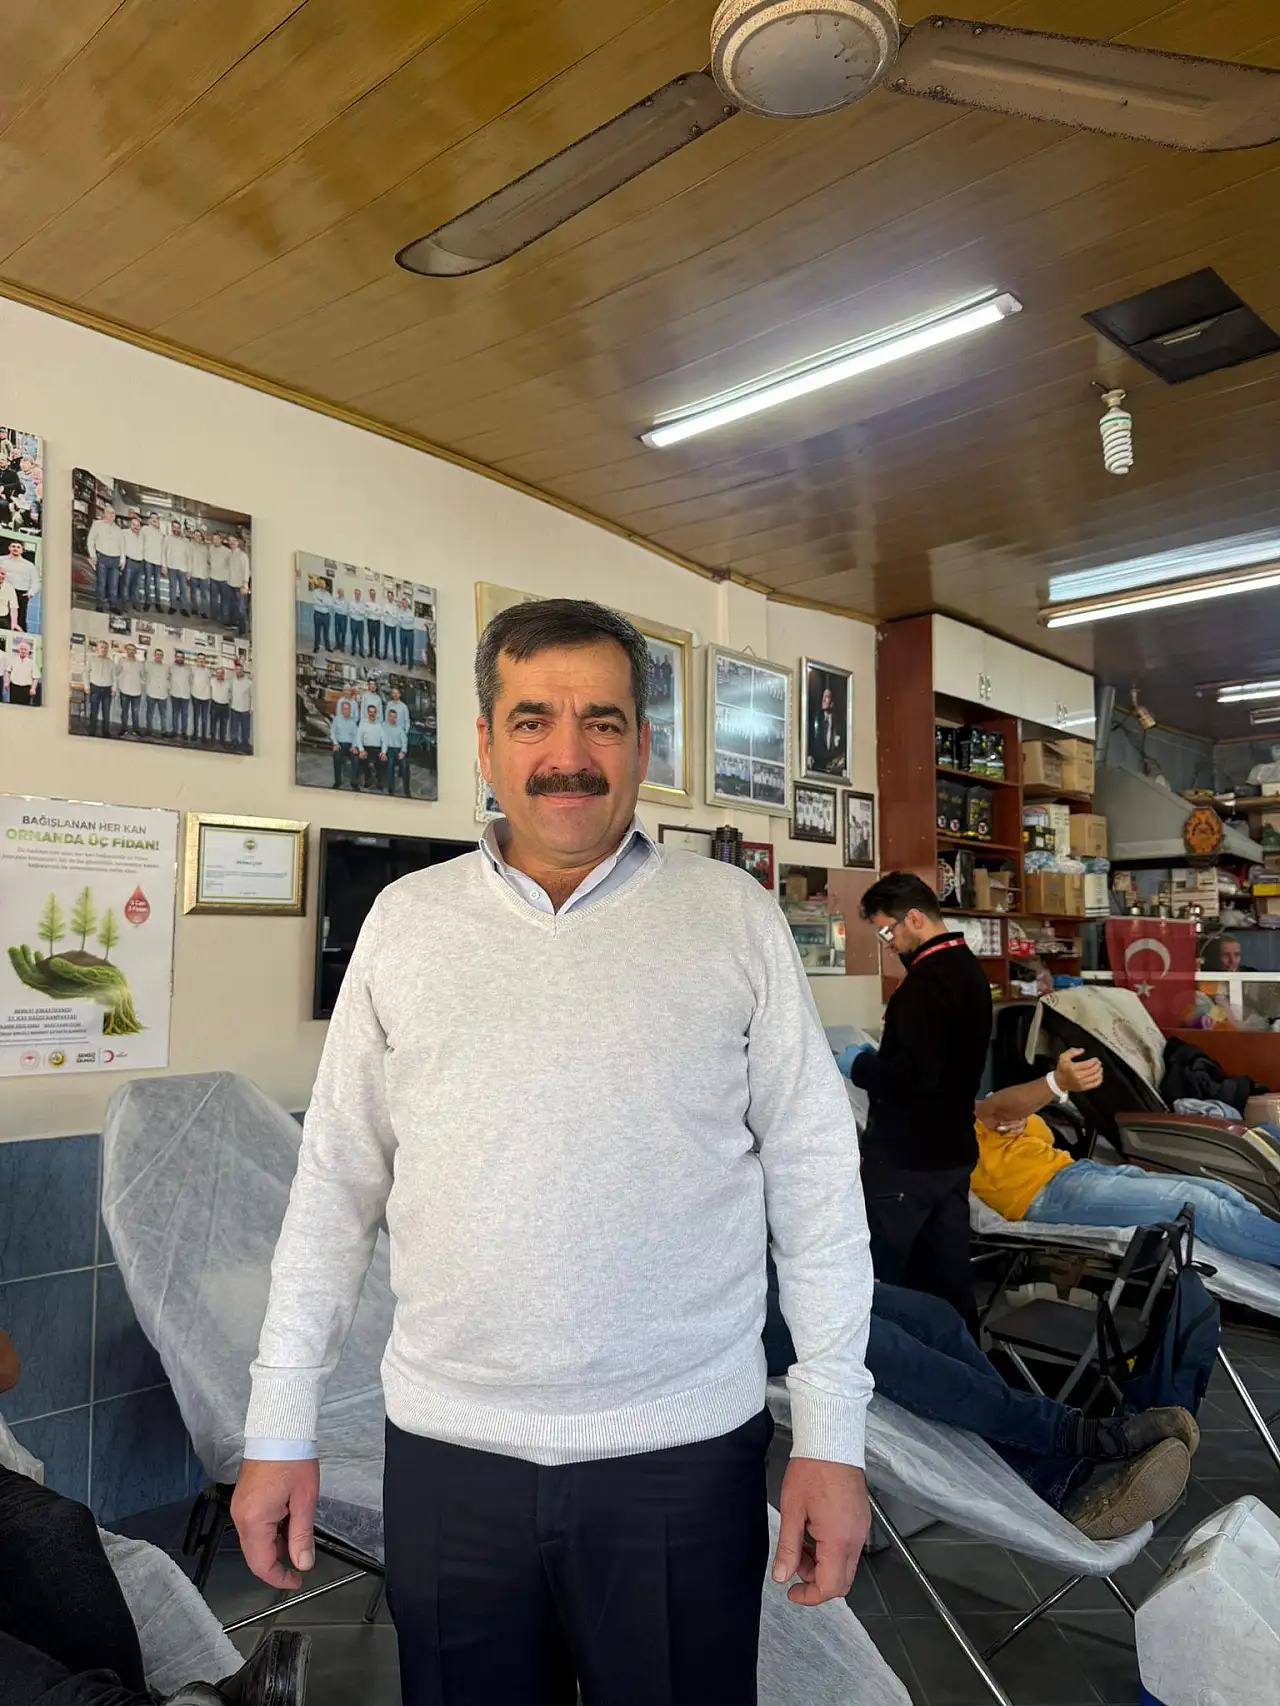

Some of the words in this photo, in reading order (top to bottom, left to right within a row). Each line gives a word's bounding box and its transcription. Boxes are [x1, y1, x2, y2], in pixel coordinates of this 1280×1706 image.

[22, 813, 96, 831] BAĞIŞLANAN
[99, 821, 121, 833] HER
[124, 824, 147, 835] KAN
[6, 828, 84, 846] ORMANDA
[88, 833, 109, 849] ÜÇ
[112, 836, 160, 851] FİDAN!
